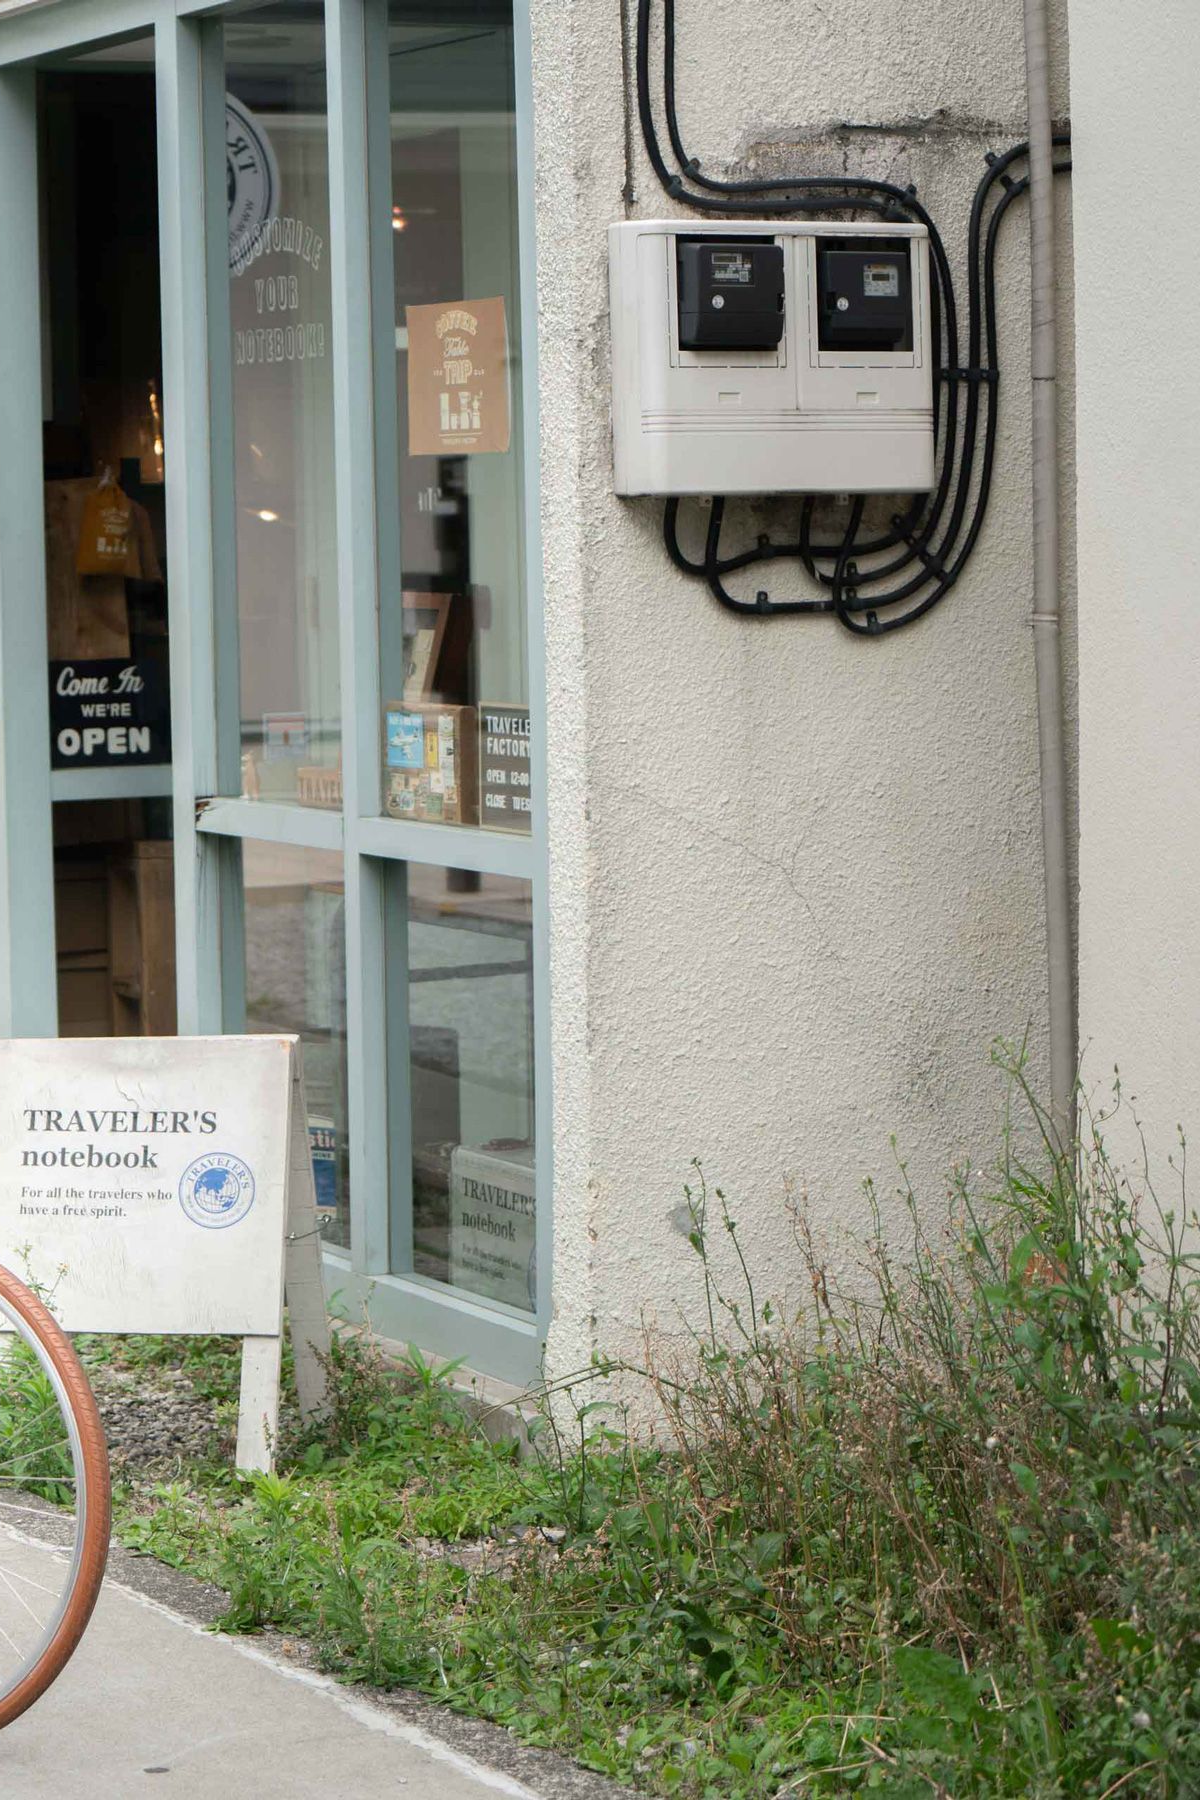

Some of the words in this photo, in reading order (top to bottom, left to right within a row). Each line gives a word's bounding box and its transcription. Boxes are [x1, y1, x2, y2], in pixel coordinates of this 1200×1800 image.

[230, 217, 324, 276] CUSTOMIZE
[254, 276, 298, 314] YOUR
[443, 359, 473, 385] TRIP
[56, 666, 109, 696] Come
[112, 665, 144, 694] In
[81, 703, 131, 717] WE'RE
[485, 715, 531, 736] TRAVELE
[57, 726, 151, 756] OPEN
[486, 769, 506, 784] OPEN
[510, 771, 530, 786] 12:00
[485, 794, 506, 808] CLOSE
[24, 1108, 217, 1134] TRAVELER'S
[21, 1144, 158, 1169] notebook
[187, 1157, 250, 1189] TRAVELER'S
[21, 1187, 43, 1198] For
[46, 1187, 61, 1198] all
[65, 1187, 85, 1199] the
[88, 1188, 143, 1200] travelers
[147, 1188, 173, 1201] who
[19, 1205, 49, 1216] have
[51, 1208, 59, 1216] a
[63, 1205, 86, 1217] free
[90, 1205, 127, 1219] spirit.
[462, 1212, 517, 1242] notebook
